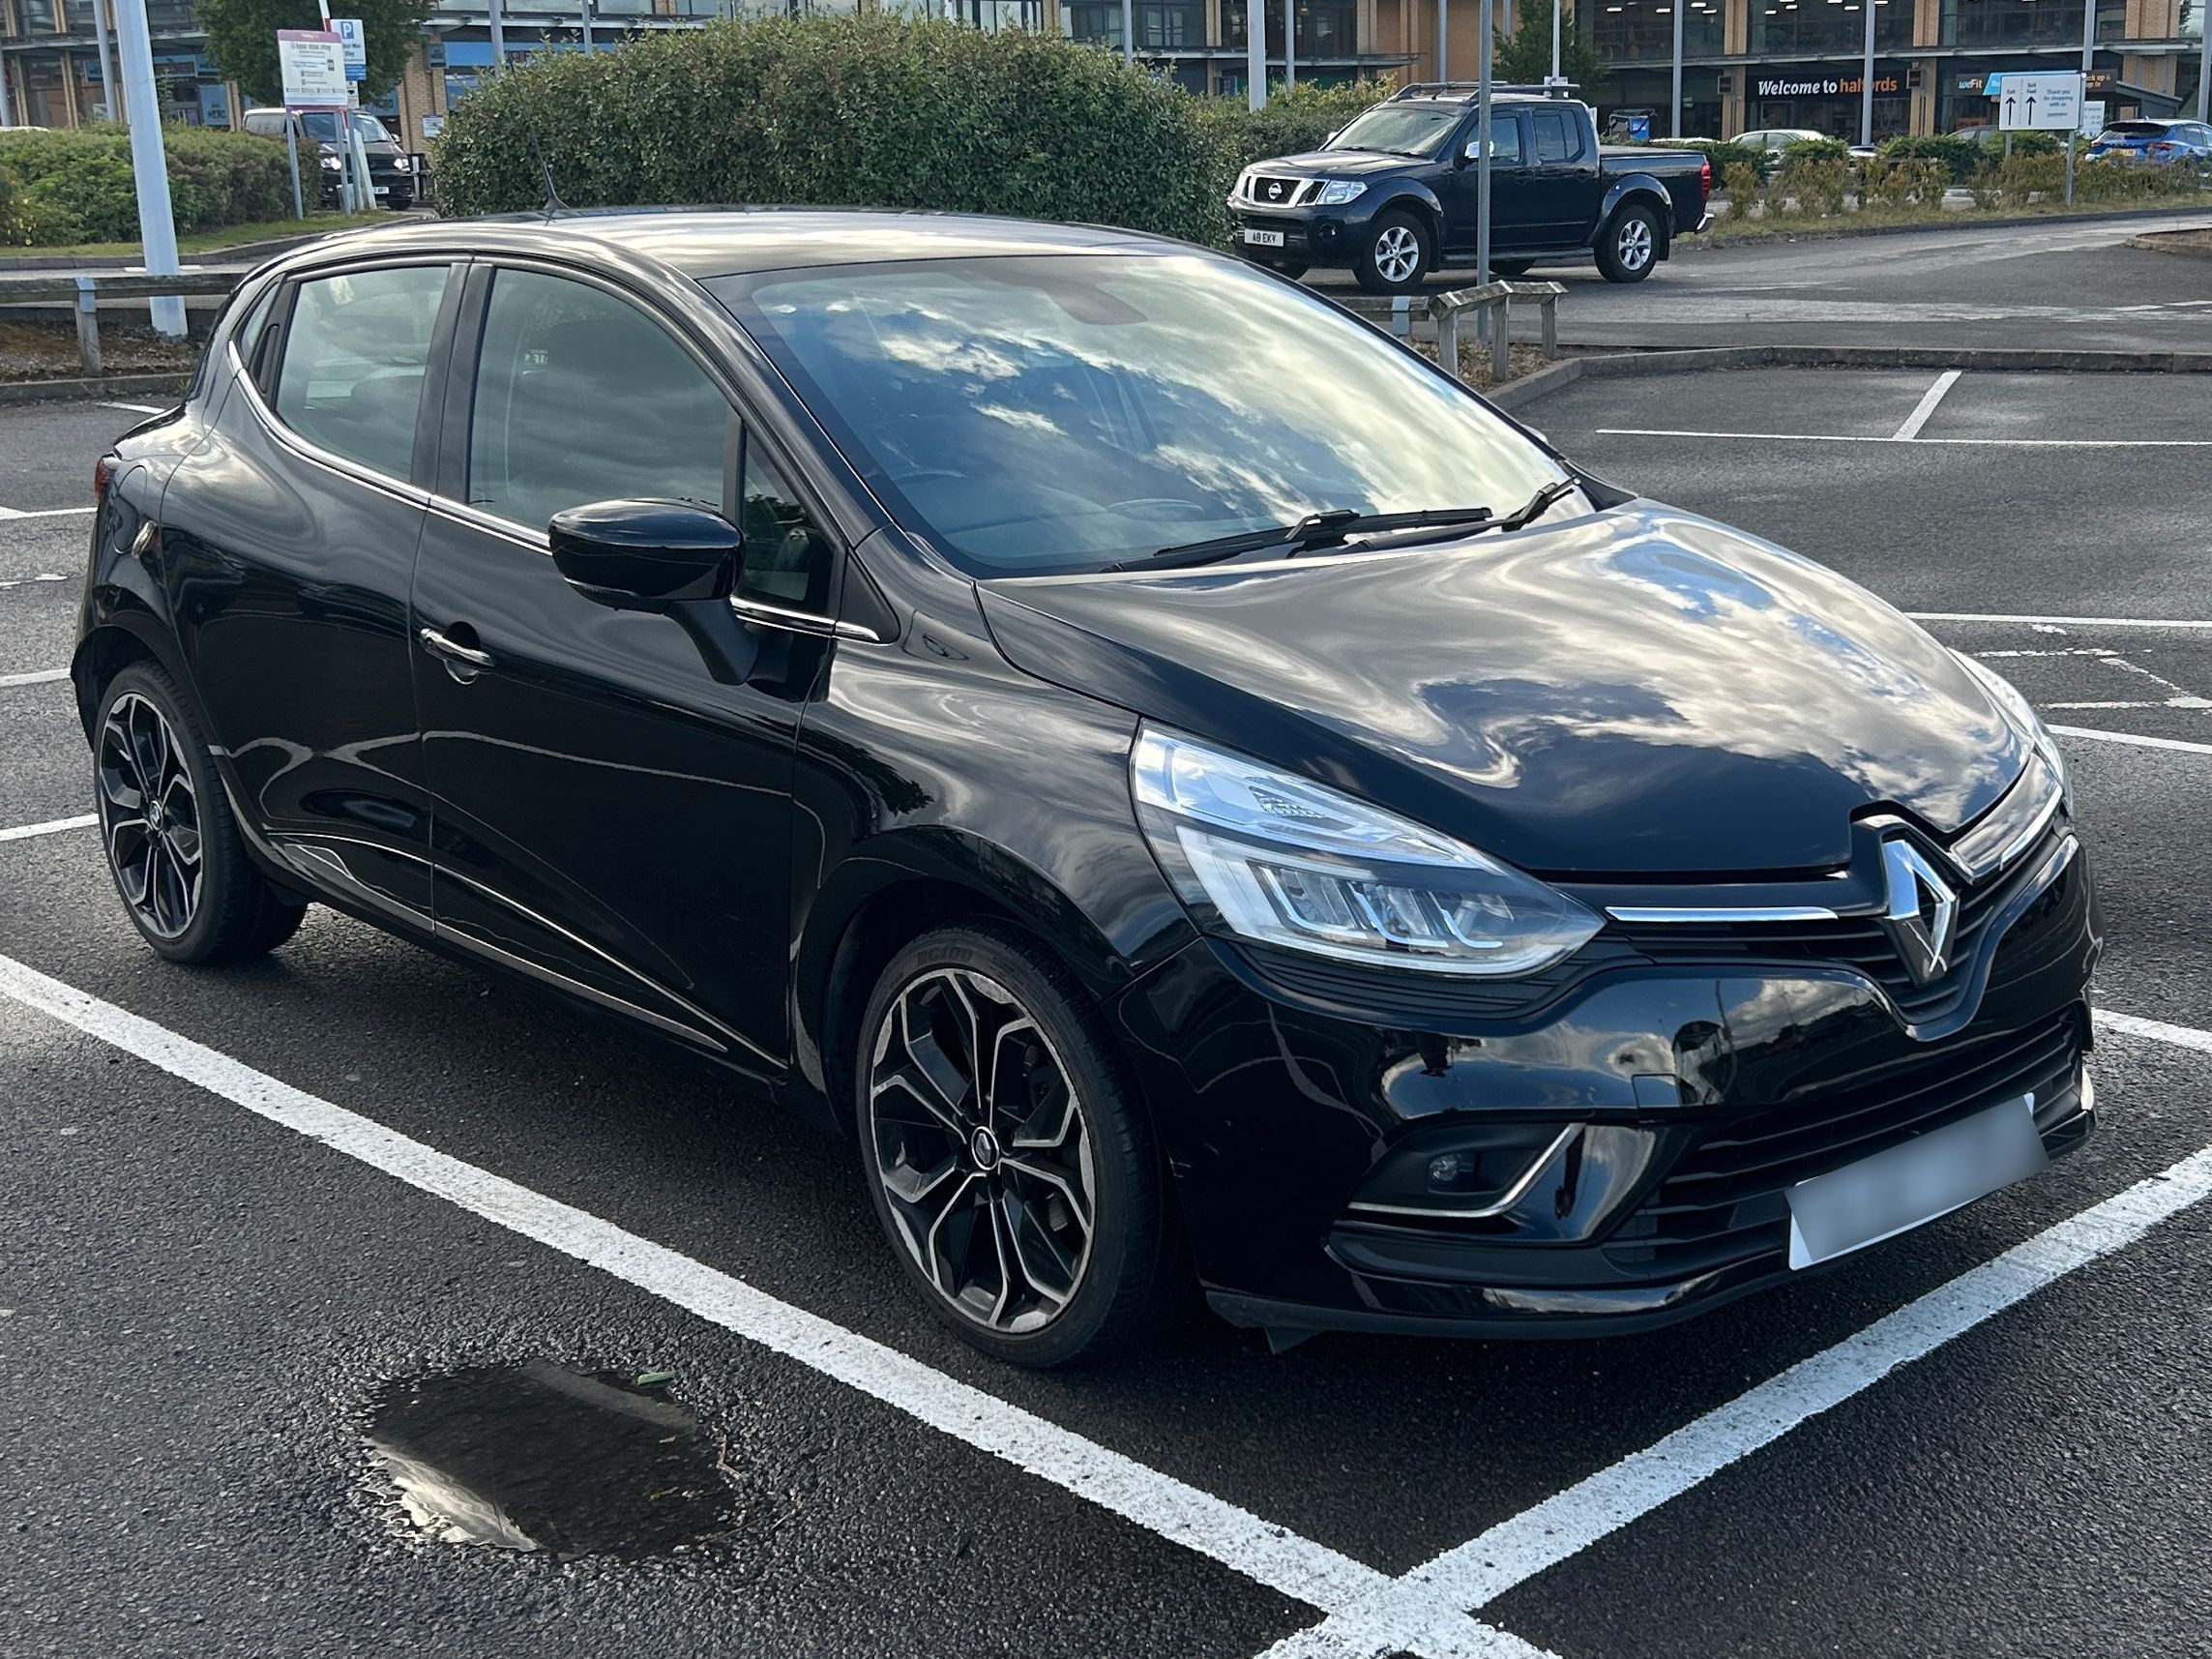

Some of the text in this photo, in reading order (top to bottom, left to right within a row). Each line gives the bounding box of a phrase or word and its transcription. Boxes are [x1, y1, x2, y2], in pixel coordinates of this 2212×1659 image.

[342, 22, 352, 38] P
[1758, 76, 1898, 96] Welcome to halrds
